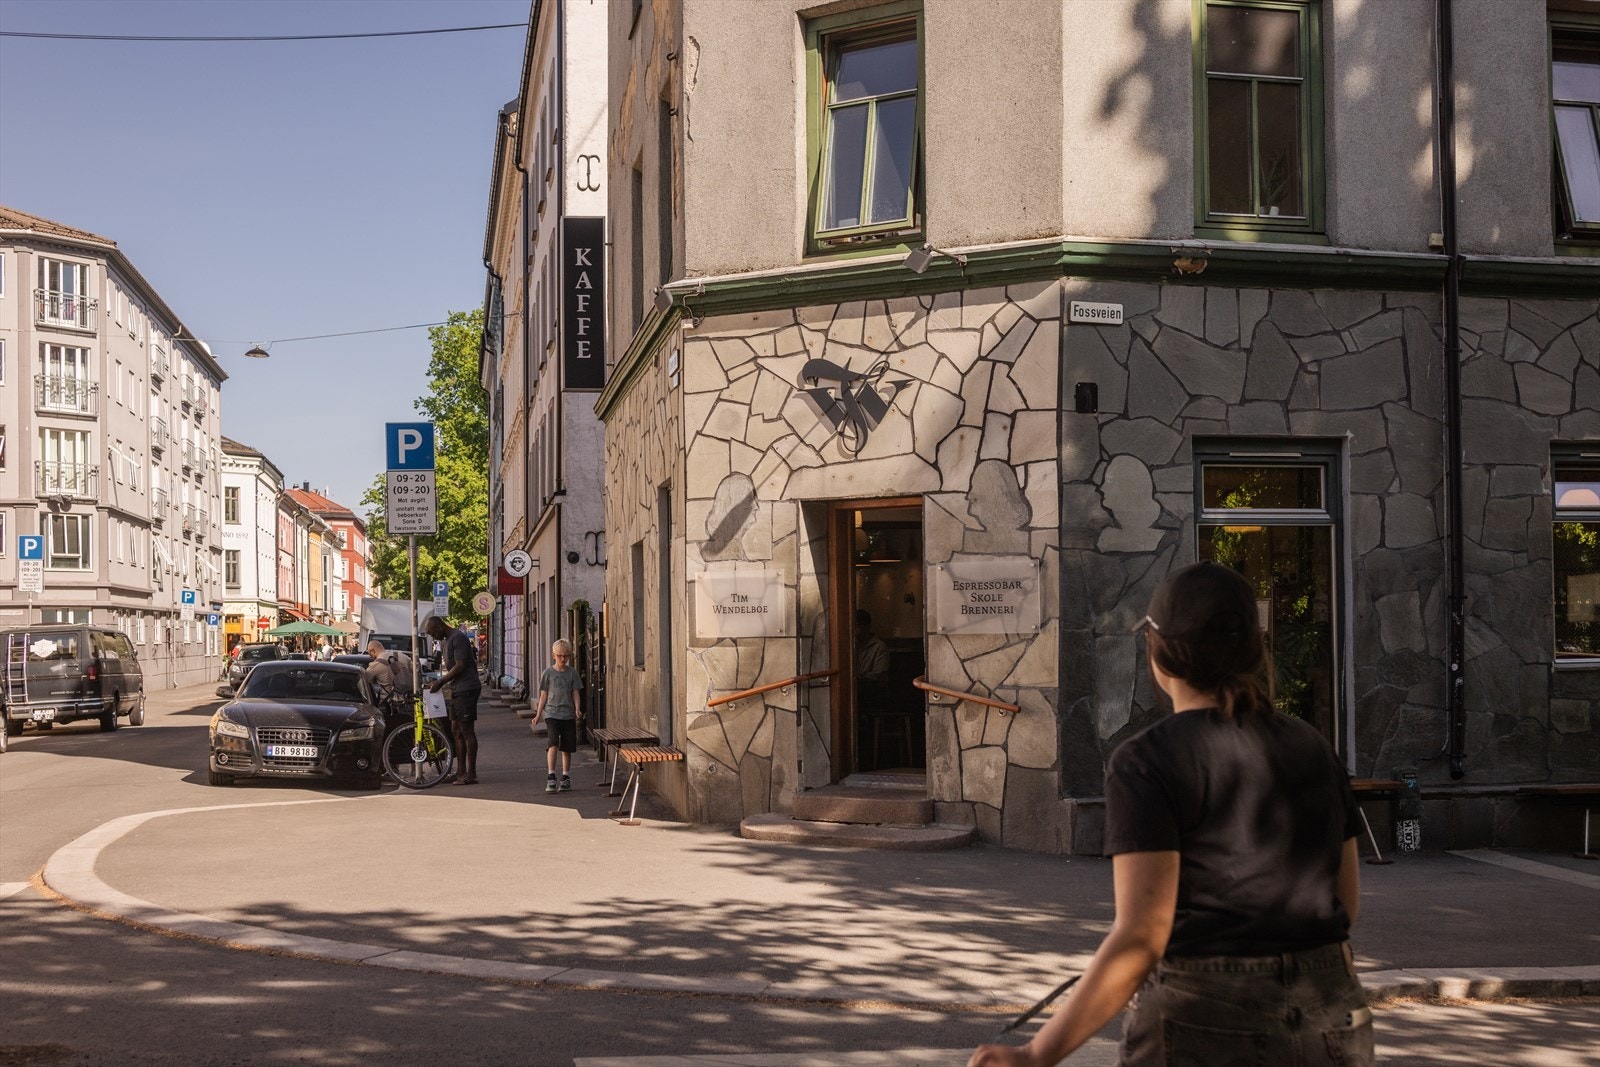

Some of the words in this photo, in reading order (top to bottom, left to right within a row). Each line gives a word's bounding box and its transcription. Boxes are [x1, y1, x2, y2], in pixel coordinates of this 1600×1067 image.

[575, 248, 592, 358] KAFFE
[1073, 304, 1121, 319] Fossveien
[398, 429, 422, 464] P
[25, 538, 38, 557] P
[436, 583, 445, 595] P
[953, 581, 1022, 591] ESPRESSOBAR
[184, 592, 192, 602] P
[731, 593, 749, 603] TIM
[971, 592, 1003, 602] SKOLE
[712, 605, 768, 614] WENDELBOE
[961, 605, 1014, 615] BRENNERI
[210, 615, 217, 624] P
[275, 747, 286, 755] BR
